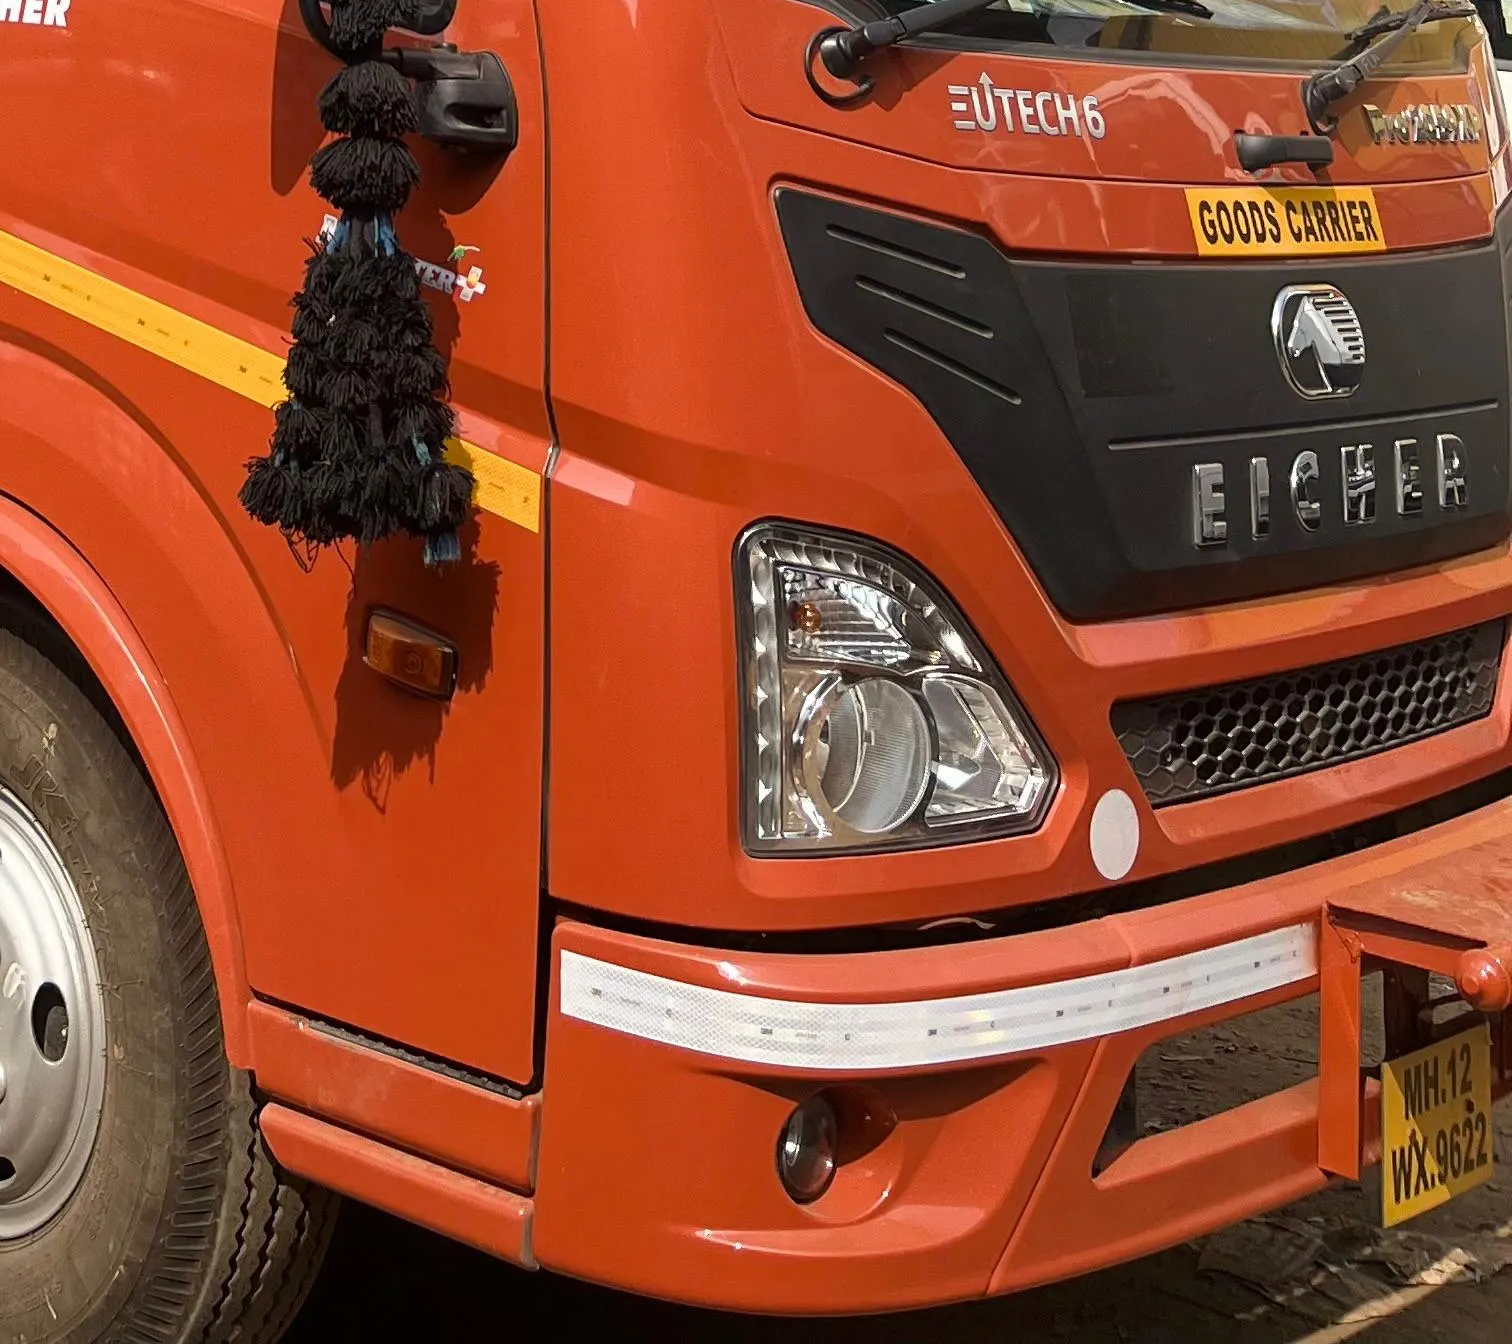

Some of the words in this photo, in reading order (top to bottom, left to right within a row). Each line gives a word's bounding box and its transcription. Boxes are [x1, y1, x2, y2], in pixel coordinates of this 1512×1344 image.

[1198, 199, 1282, 245] GOODS
[1285, 199, 1379, 244] CARRIER
[1191, 433, 1470, 550] EICHER
[1404, 1042, 1473, 1120] MH.12
[1391, 1111, 1488, 1205] WX.9622
